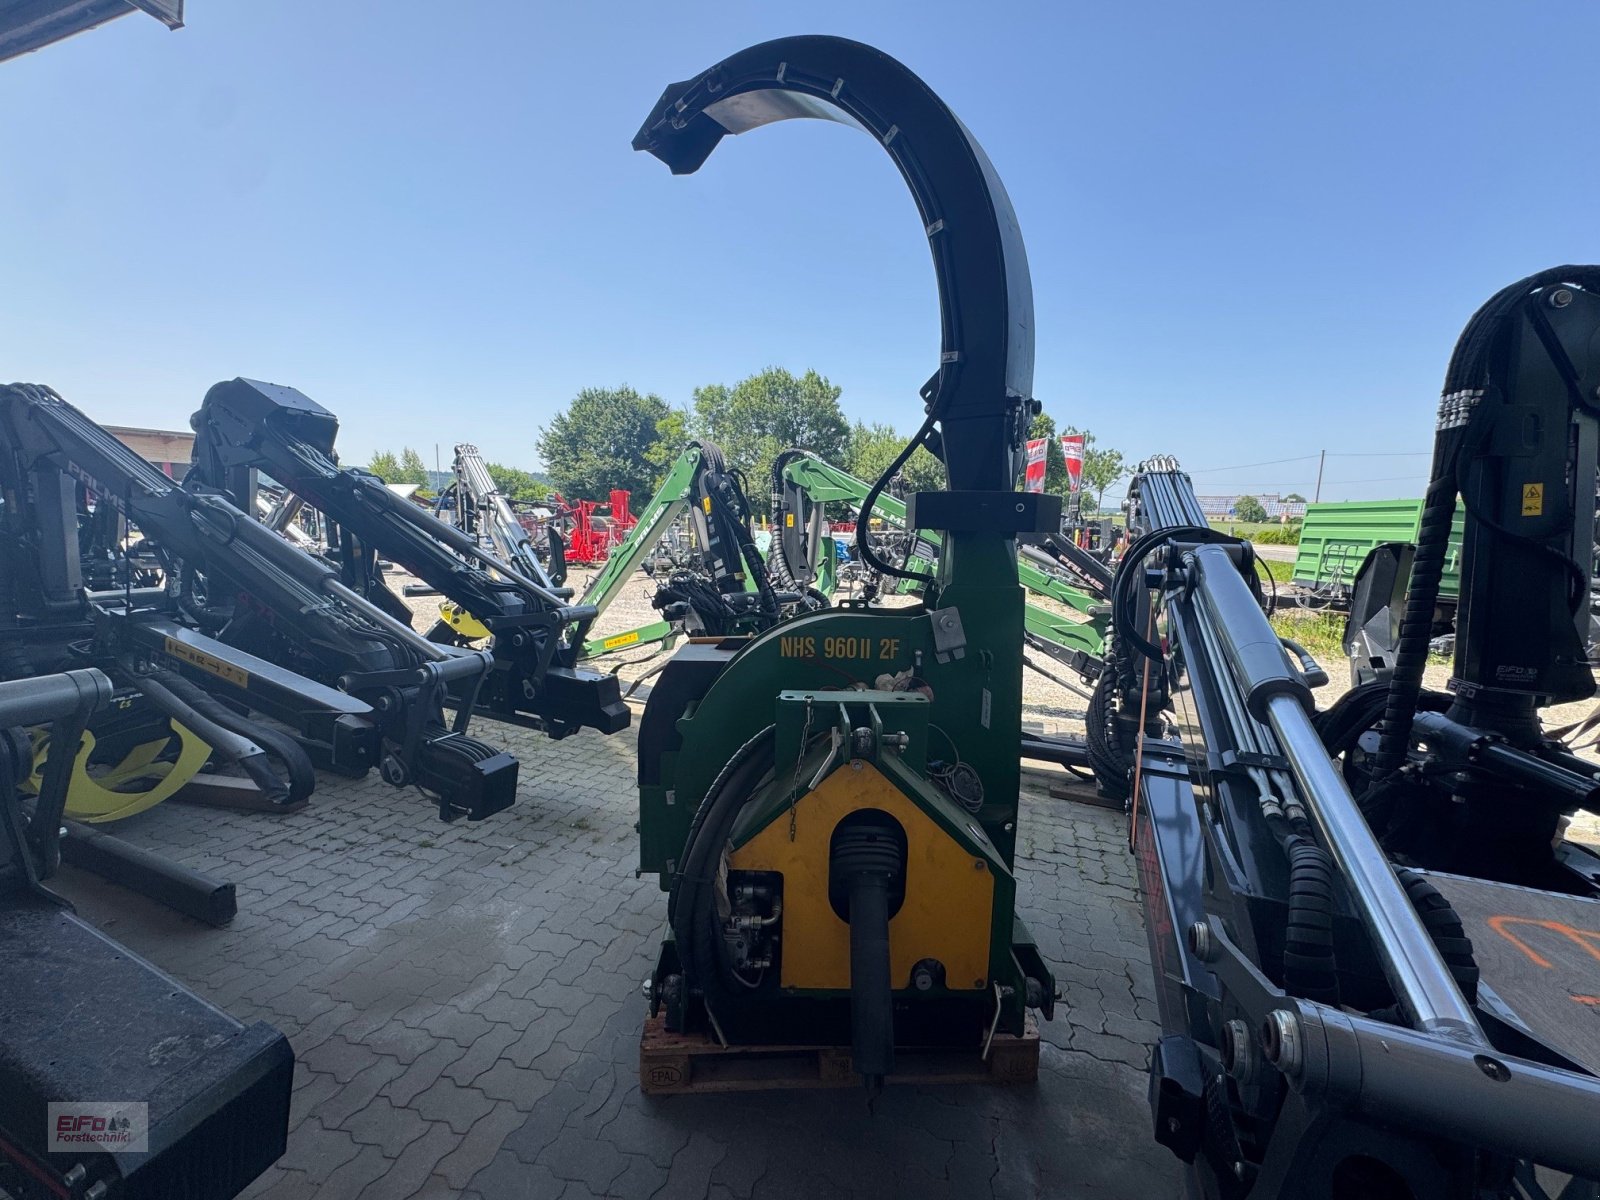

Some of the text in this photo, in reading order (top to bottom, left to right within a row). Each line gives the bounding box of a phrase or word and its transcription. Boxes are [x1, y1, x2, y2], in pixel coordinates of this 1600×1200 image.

[634, 506, 664, 548] PALMS
[1059, 554, 1105, 591] PALMS
[780, 637, 815, 658] NHS
[824, 637, 857, 659] 960
[879, 638, 900, 660] 2F
[1448, 681, 1476, 699] EIFO
[651, 1071, 677, 1083] EPAL
